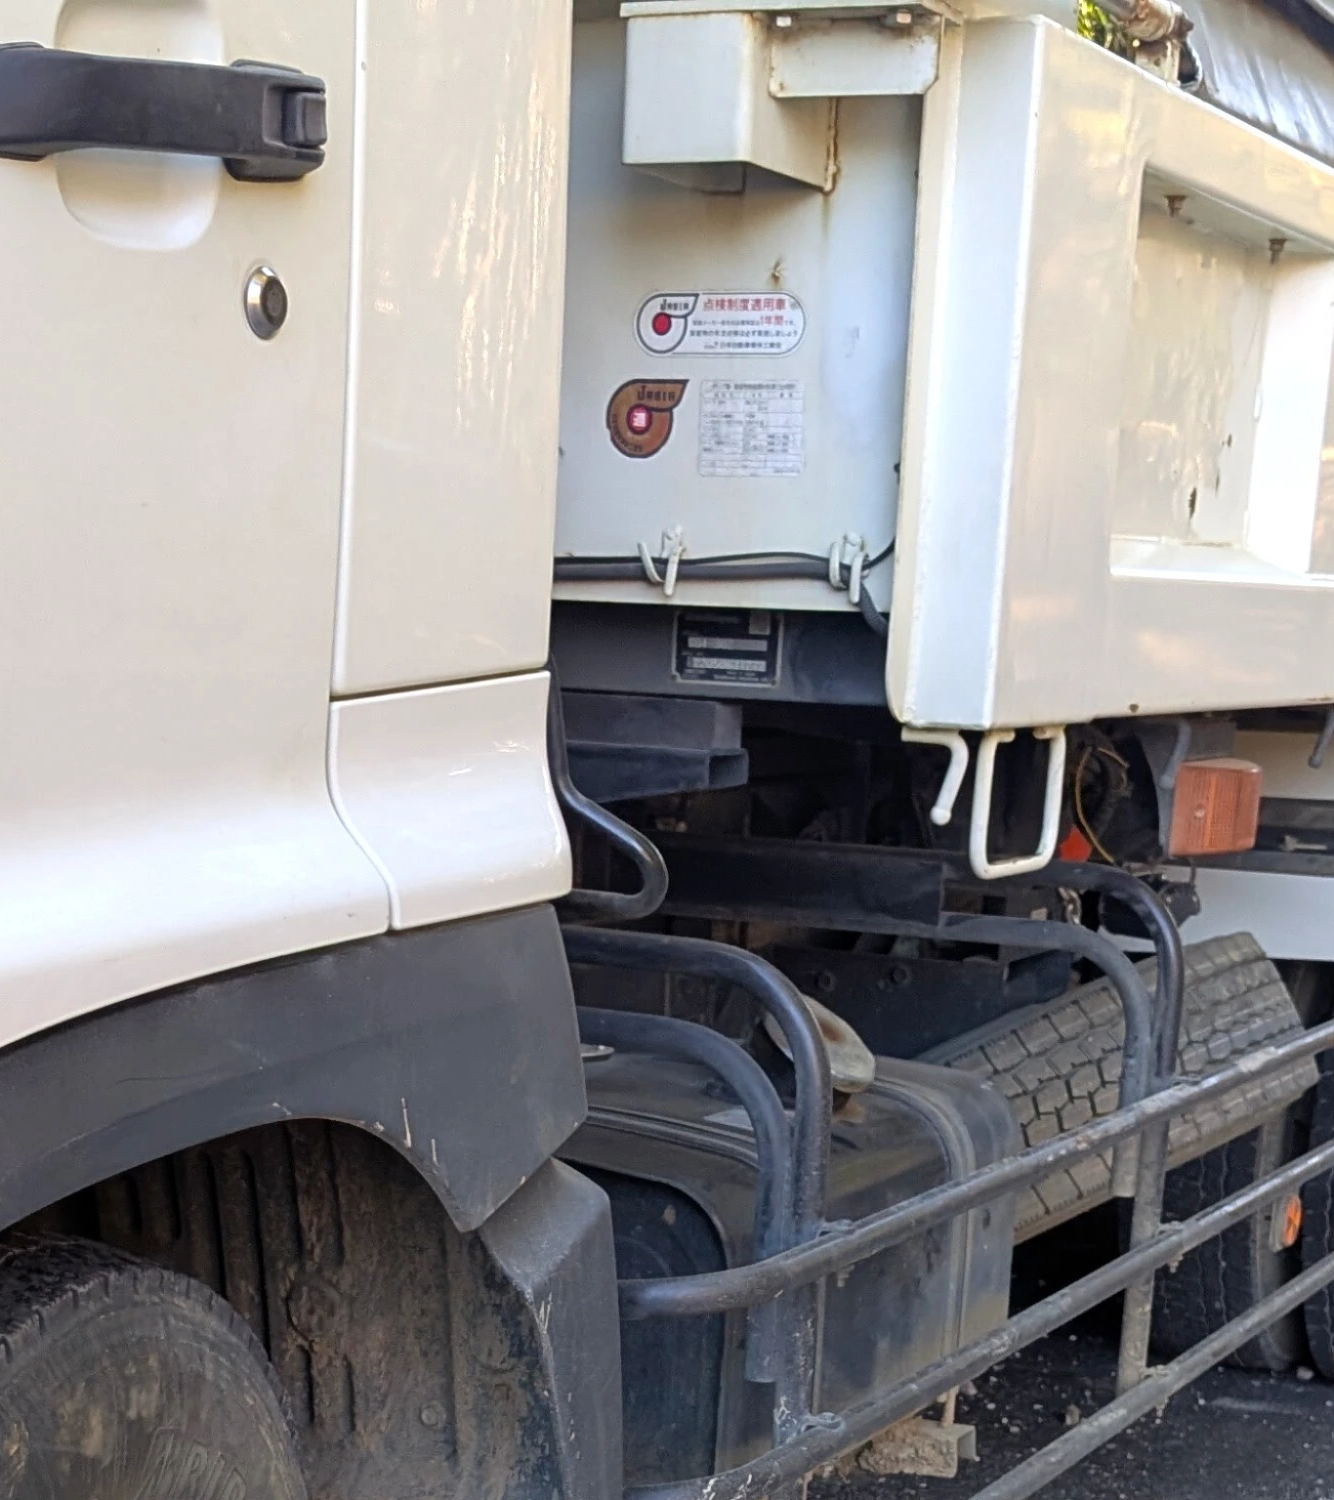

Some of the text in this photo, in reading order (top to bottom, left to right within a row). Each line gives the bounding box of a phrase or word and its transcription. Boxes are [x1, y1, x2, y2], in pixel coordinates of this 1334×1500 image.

[703, 298, 786, 312] 点検制度適用車
